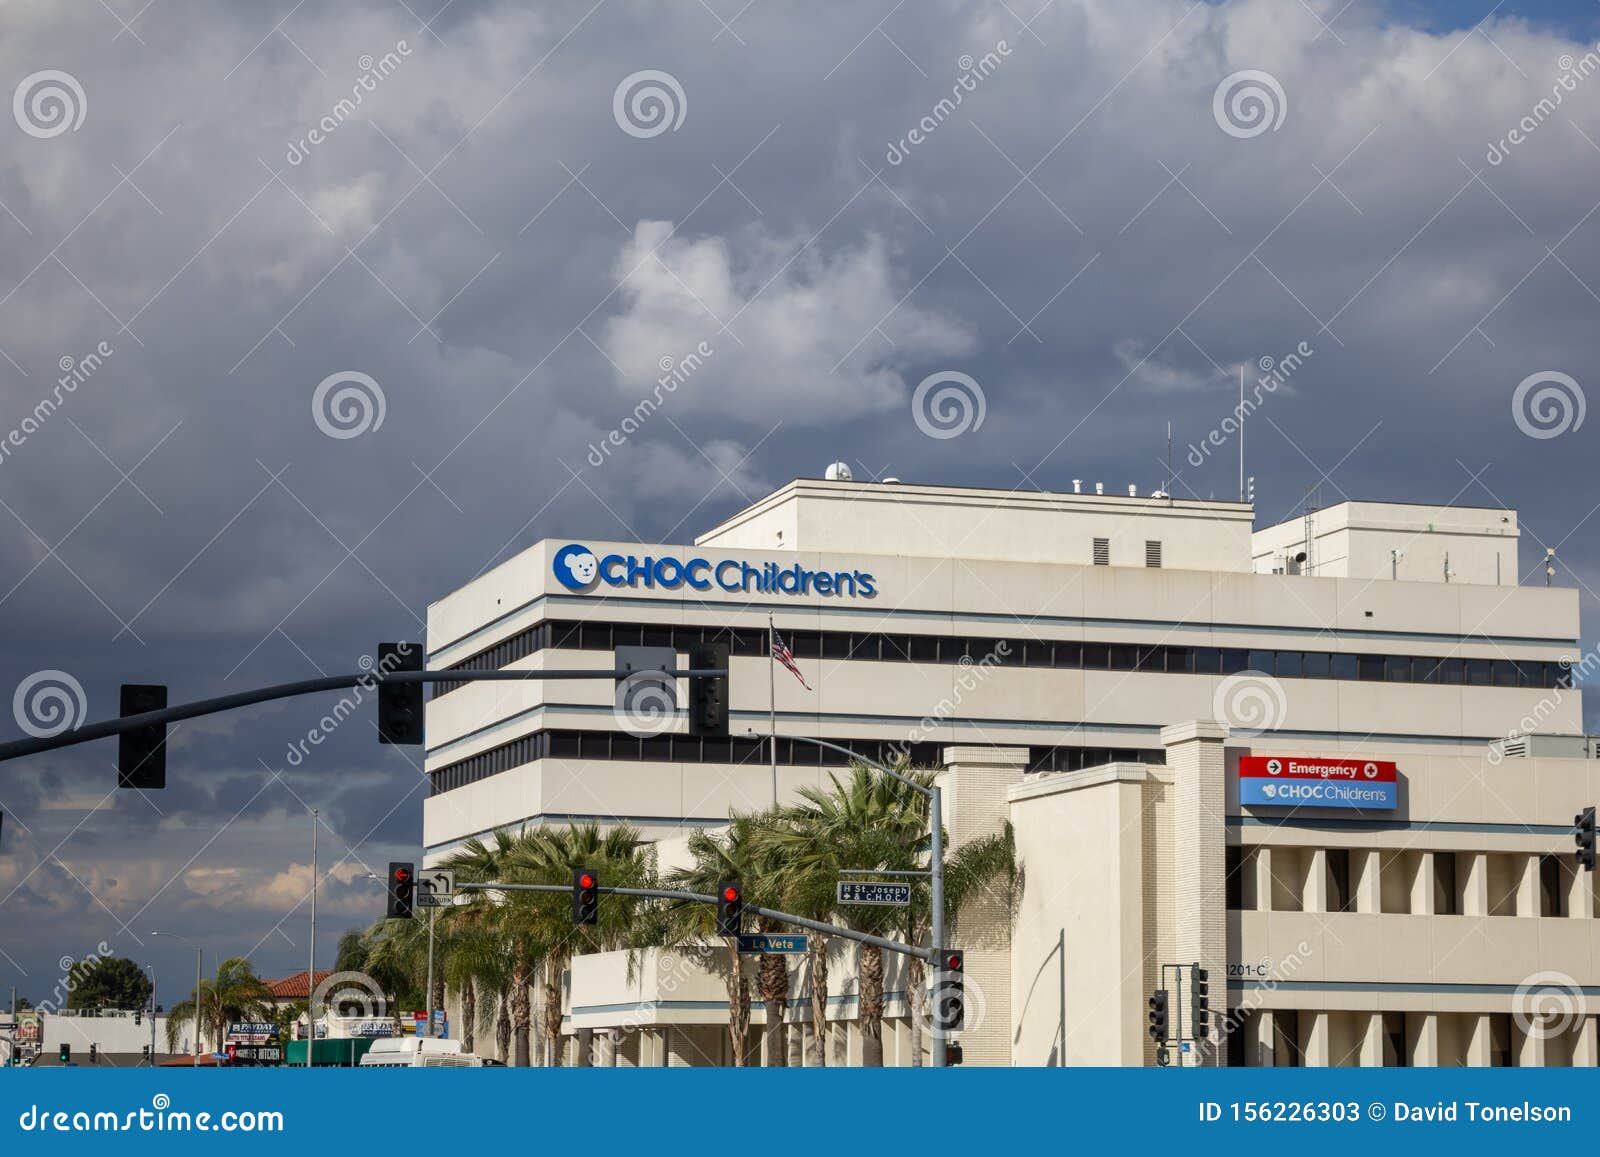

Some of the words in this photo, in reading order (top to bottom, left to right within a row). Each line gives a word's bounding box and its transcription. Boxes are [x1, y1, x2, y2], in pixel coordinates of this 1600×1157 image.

[599, 554, 712, 589] CHOC
[715, 559, 878, 597] Children's
[1289, 762, 1357, 777] Emergency
[1278, 785, 1323, 798] CHOC
[1324, 785, 1386, 801] Children's
[855, 885, 868, 893] St.
[871, 886, 907, 896] Joseph
[752, 938, 765, 949] La
[768, 938, 793, 950] Veta
